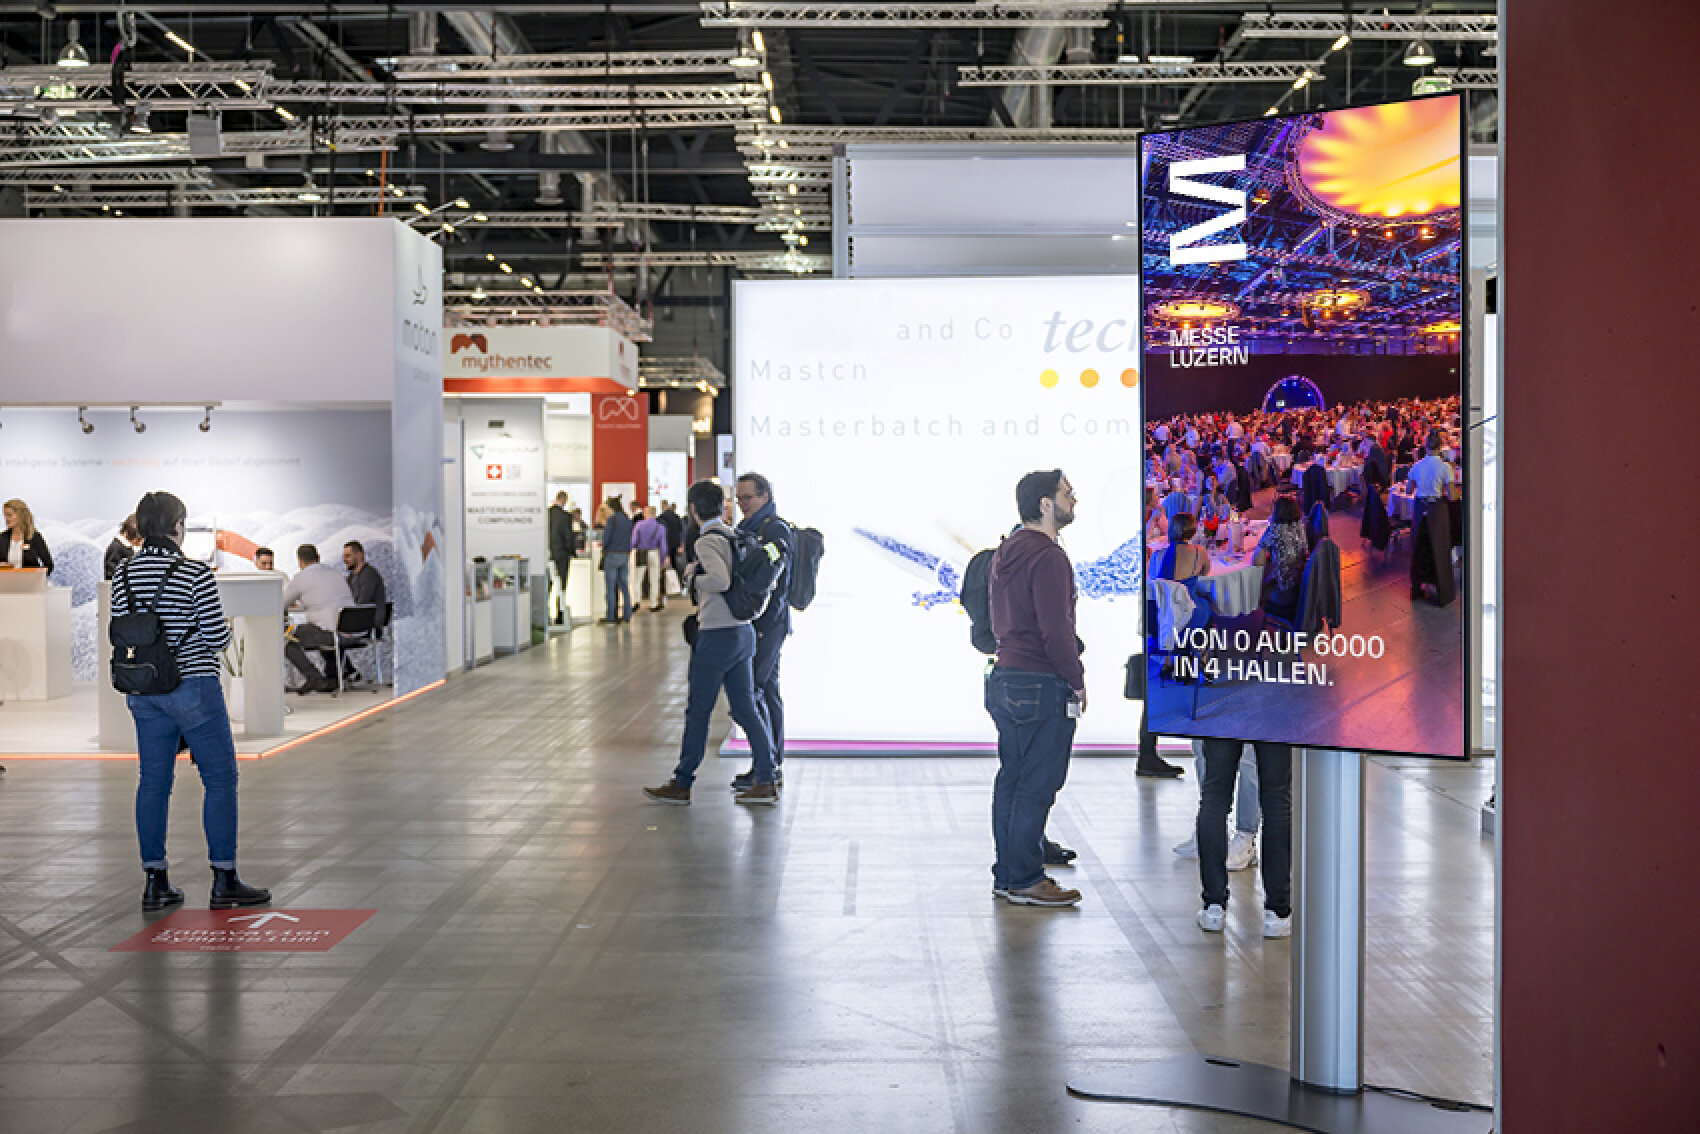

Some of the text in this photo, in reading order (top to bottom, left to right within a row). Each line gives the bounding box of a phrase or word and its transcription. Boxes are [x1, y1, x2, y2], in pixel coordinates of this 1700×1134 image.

[896, 316, 1014, 340] and Co
[1042, 309, 1138, 354] tec
[1169, 326, 1240, 347] MESSE
[461, 354, 553, 372] mythentec
[1169, 345, 1249, 369] LUZERN
[750, 415, 963, 437] Masterbatch
[982, 415, 1040, 436] and
[1172, 627, 1385, 659] VON 0 AUF 6000
[1172, 655, 1335, 687] IN 4 HALLEN.
